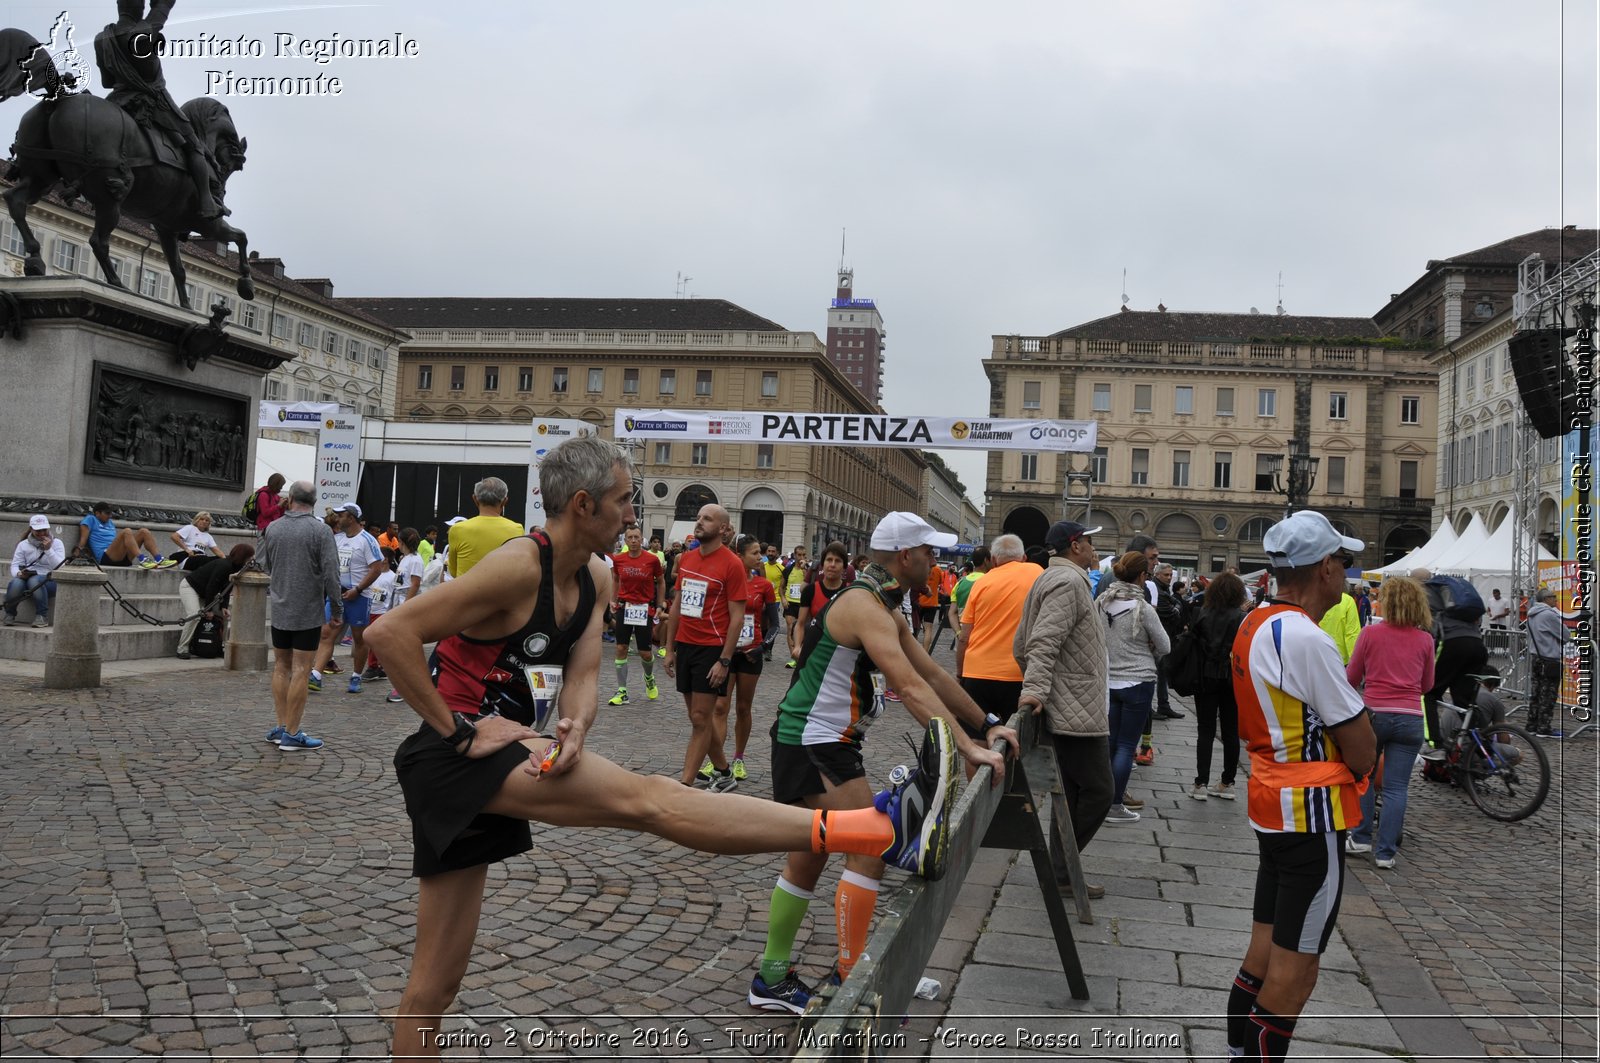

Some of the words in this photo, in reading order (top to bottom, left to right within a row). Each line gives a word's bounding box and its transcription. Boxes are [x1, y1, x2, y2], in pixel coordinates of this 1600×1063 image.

[663, 422, 686, 430] TORINO
[722, 421, 752, 429] REGIONE
[762, 415, 933, 443] PARTENZA
[970, 422, 992, 431] TEAM
[969, 431, 1013, 440] MARATHON
[627, 608, 646, 619] 1342
